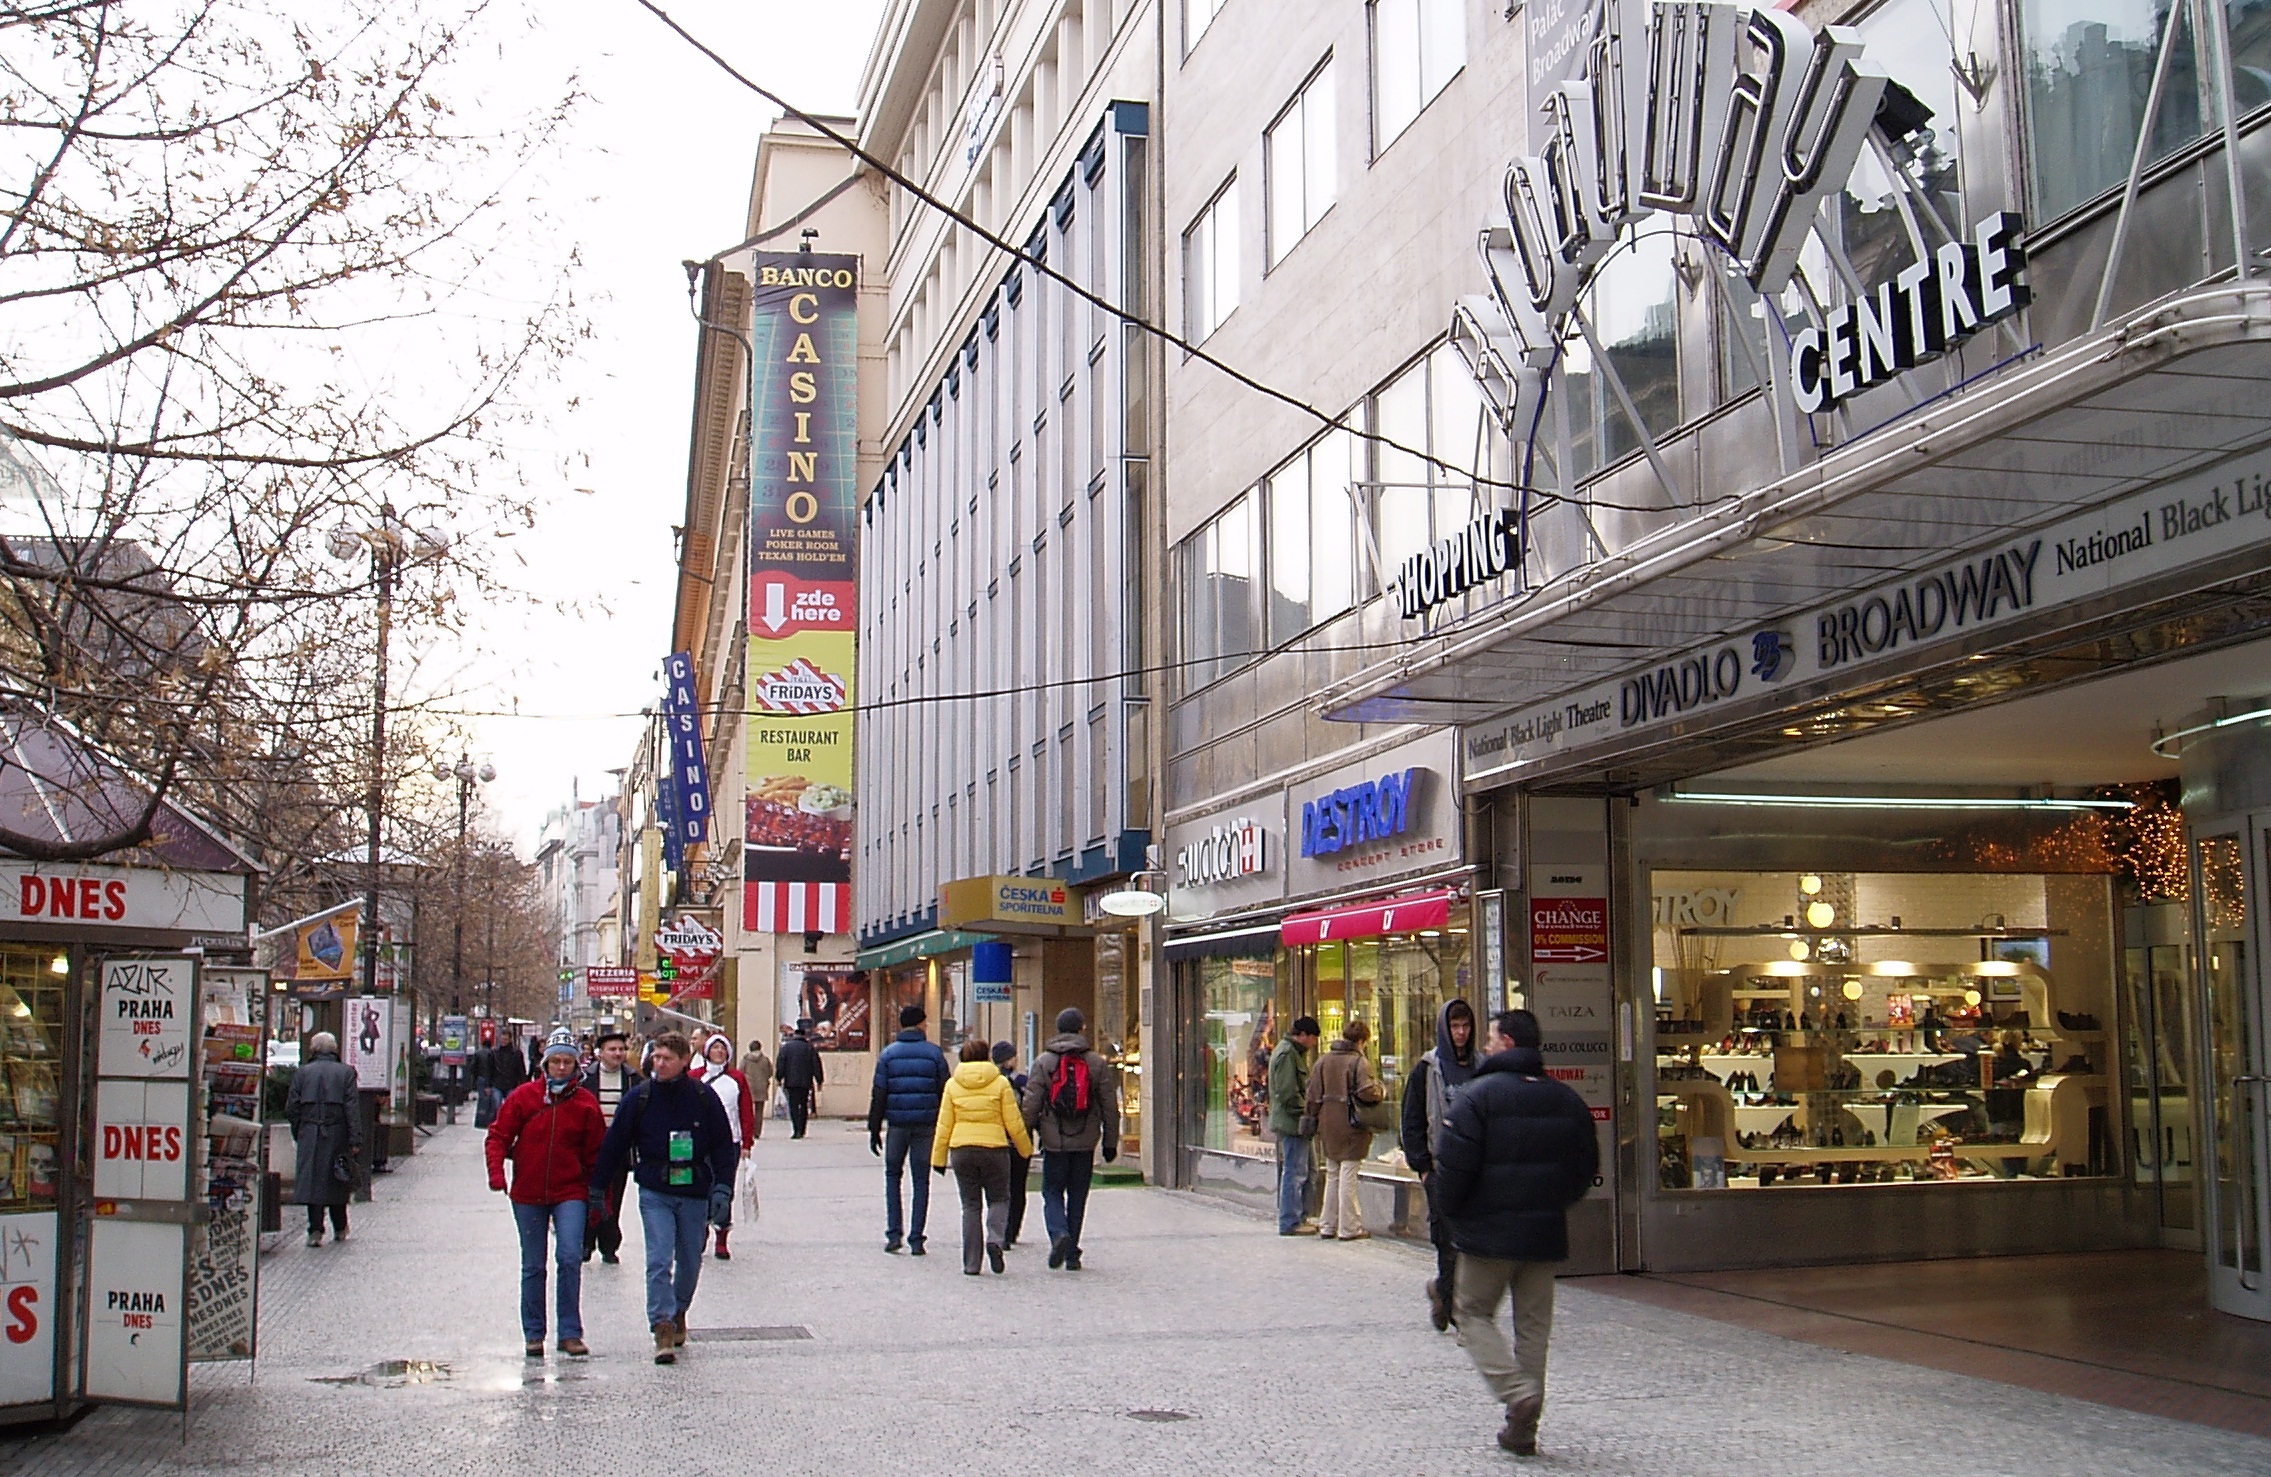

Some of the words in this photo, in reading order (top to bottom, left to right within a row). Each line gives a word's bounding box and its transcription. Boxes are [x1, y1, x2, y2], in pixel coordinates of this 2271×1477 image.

[761, 267, 853, 289] BANCO
[1790, 210, 2018, 415] CENTRE
[785, 292, 821, 525] CASINO
[769, 528, 795, 538] LIVE
[797, 530, 835, 539] GAMES
[2056, 510, 2153, 577] National
[2159, 486, 2232, 542] Black
[765, 540, 803, 550] POKER
[806, 541, 839, 551] ROOM
[758, 551, 794, 561] TEXAS
[796, 588, 836, 606] zde
[791, 603, 842, 621] here
[1620, 646, 1741, 728] DIVADLO
[1816, 538, 2043, 669] BROADWAY
[672, 660, 704, 813] CASINO
[760, 730, 840, 745] RESTAURANT
[1468, 727, 1508, 760] National
[1510, 718, 1536, 748] Black
[1536, 710, 1563, 744] Light
[1565, 699, 1612, 731] Theatre
[786, 748, 812, 762] BAR
[1301, 766, 1415, 859] DESTROY
[1336, 851, 1392, 873] CONCEPT
[1400, 837, 1445, 858] STORE
[19, 874, 127, 921] DNES
[999, 884, 1050, 902] ČESKÁ
[999, 901, 1065, 916] SPOŘITELNA
[1534, 910, 1602, 924] CHANGE
[1534, 934, 1548, 945] 0%
[1548, 933, 1605, 945] COMMISSION
[589, 968, 636, 978] PIZZERIA
[118, 1000, 174, 1019] PRAHA
[1547, 1006, 1596, 1018] TAIZA
[132, 1020, 162, 1035] DNES
[103, 1124, 182, 1163] DNES
[107, 1290, 166, 1314] PRAHA
[123, 1312, 154, 1330] DNES
